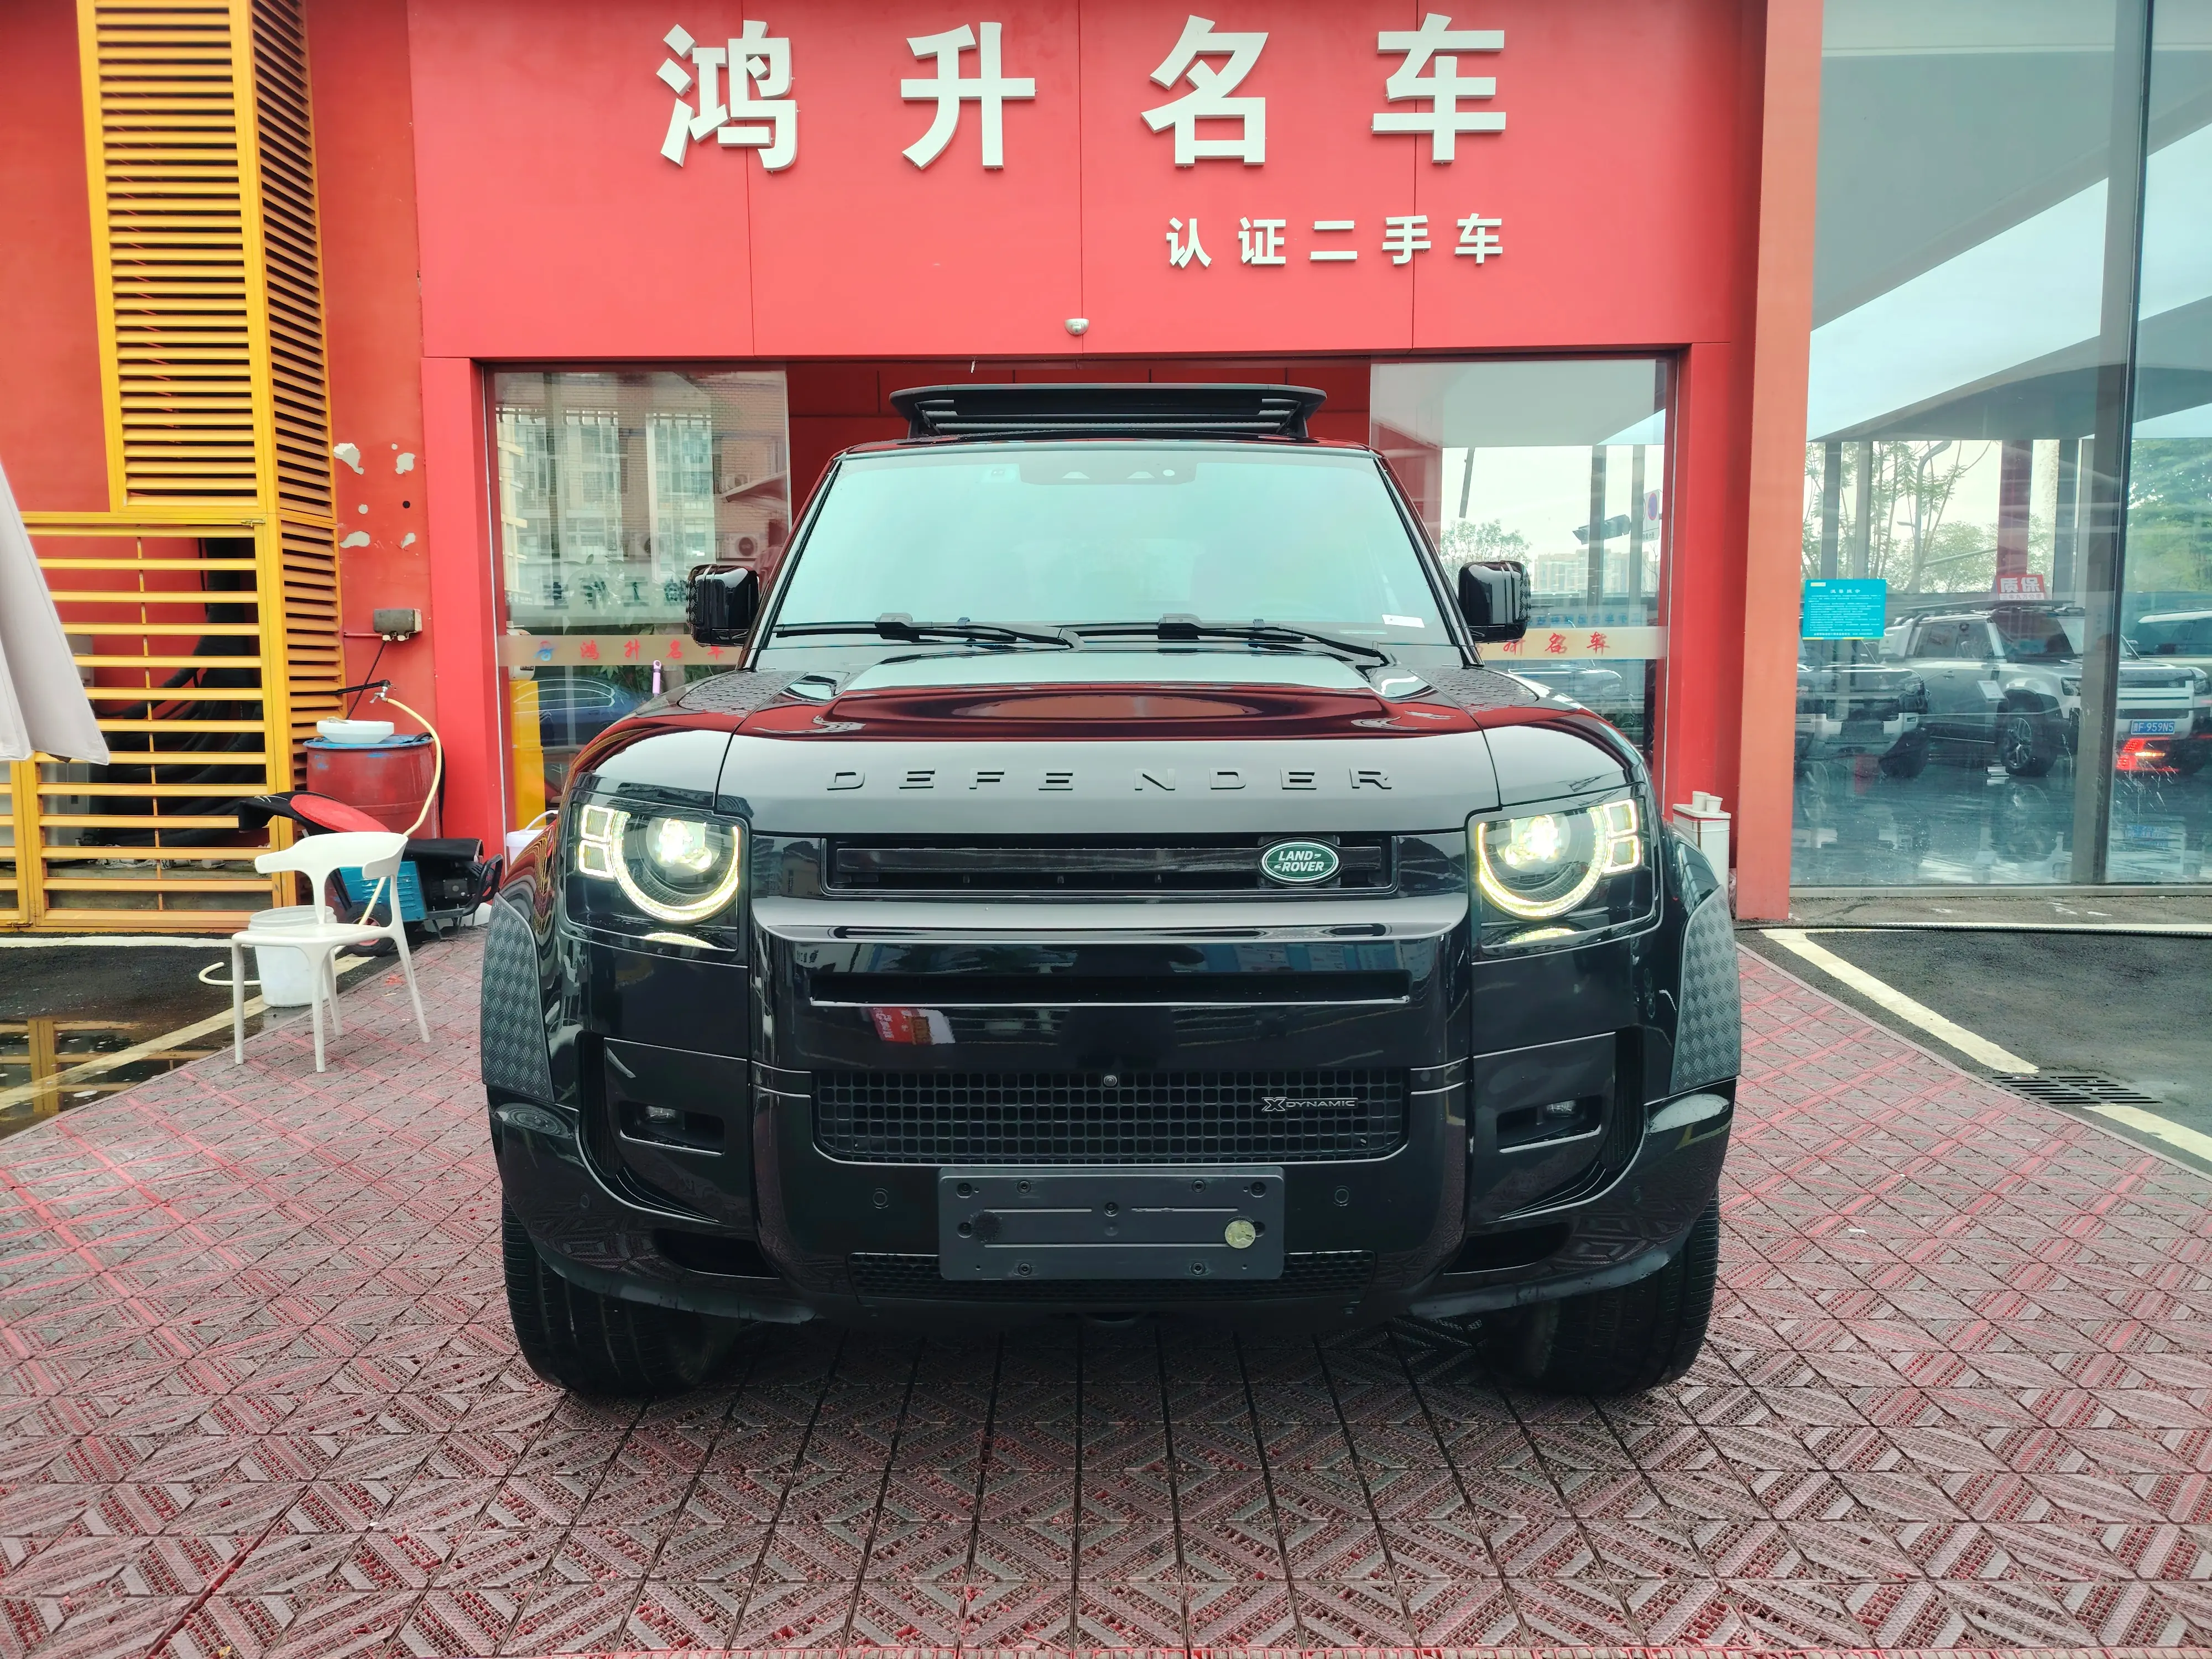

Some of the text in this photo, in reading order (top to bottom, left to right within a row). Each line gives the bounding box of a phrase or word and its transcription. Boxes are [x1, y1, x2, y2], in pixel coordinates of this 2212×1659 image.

[656, 13, 1506, 171] 鸿升名车
[1166, 213, 1504, 269] 认证二手车
[2000, 577, 2041, 593] 质保
[826, 767, 1392, 791] DEFENDER
[1279, 851, 1313, 861] LAND
[1281, 861, 1324, 872] ROVER
